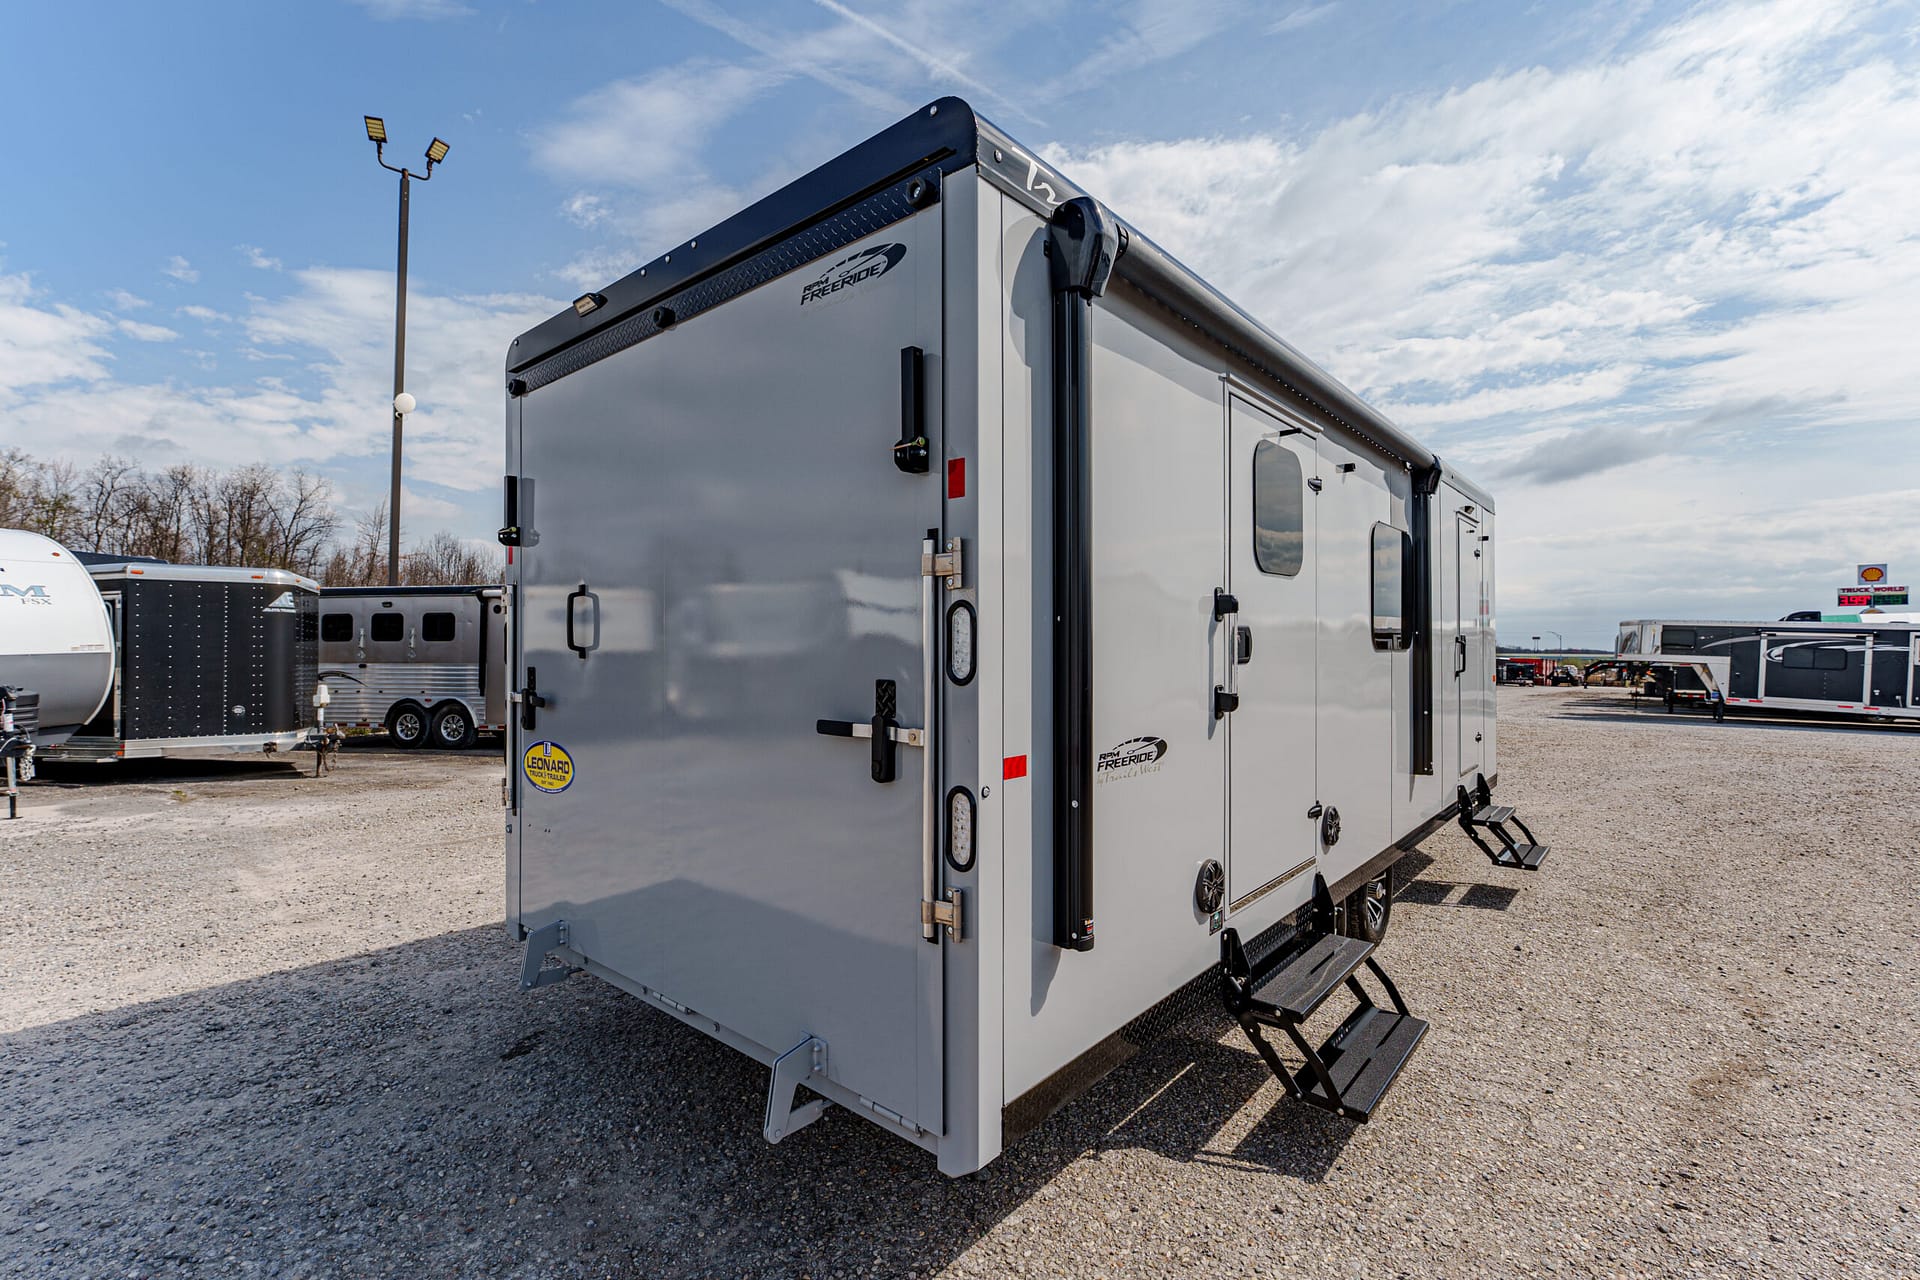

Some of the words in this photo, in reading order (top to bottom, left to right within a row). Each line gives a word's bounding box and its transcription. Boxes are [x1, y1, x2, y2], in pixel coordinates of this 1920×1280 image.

[800, 262, 882, 306] FREERIDE
[802, 276, 830, 294] RPM
[526, 756, 570, 775] LEONARD
[1096, 751, 1155, 773] FREERIDE
[1098, 750, 1121, 762] RPM
